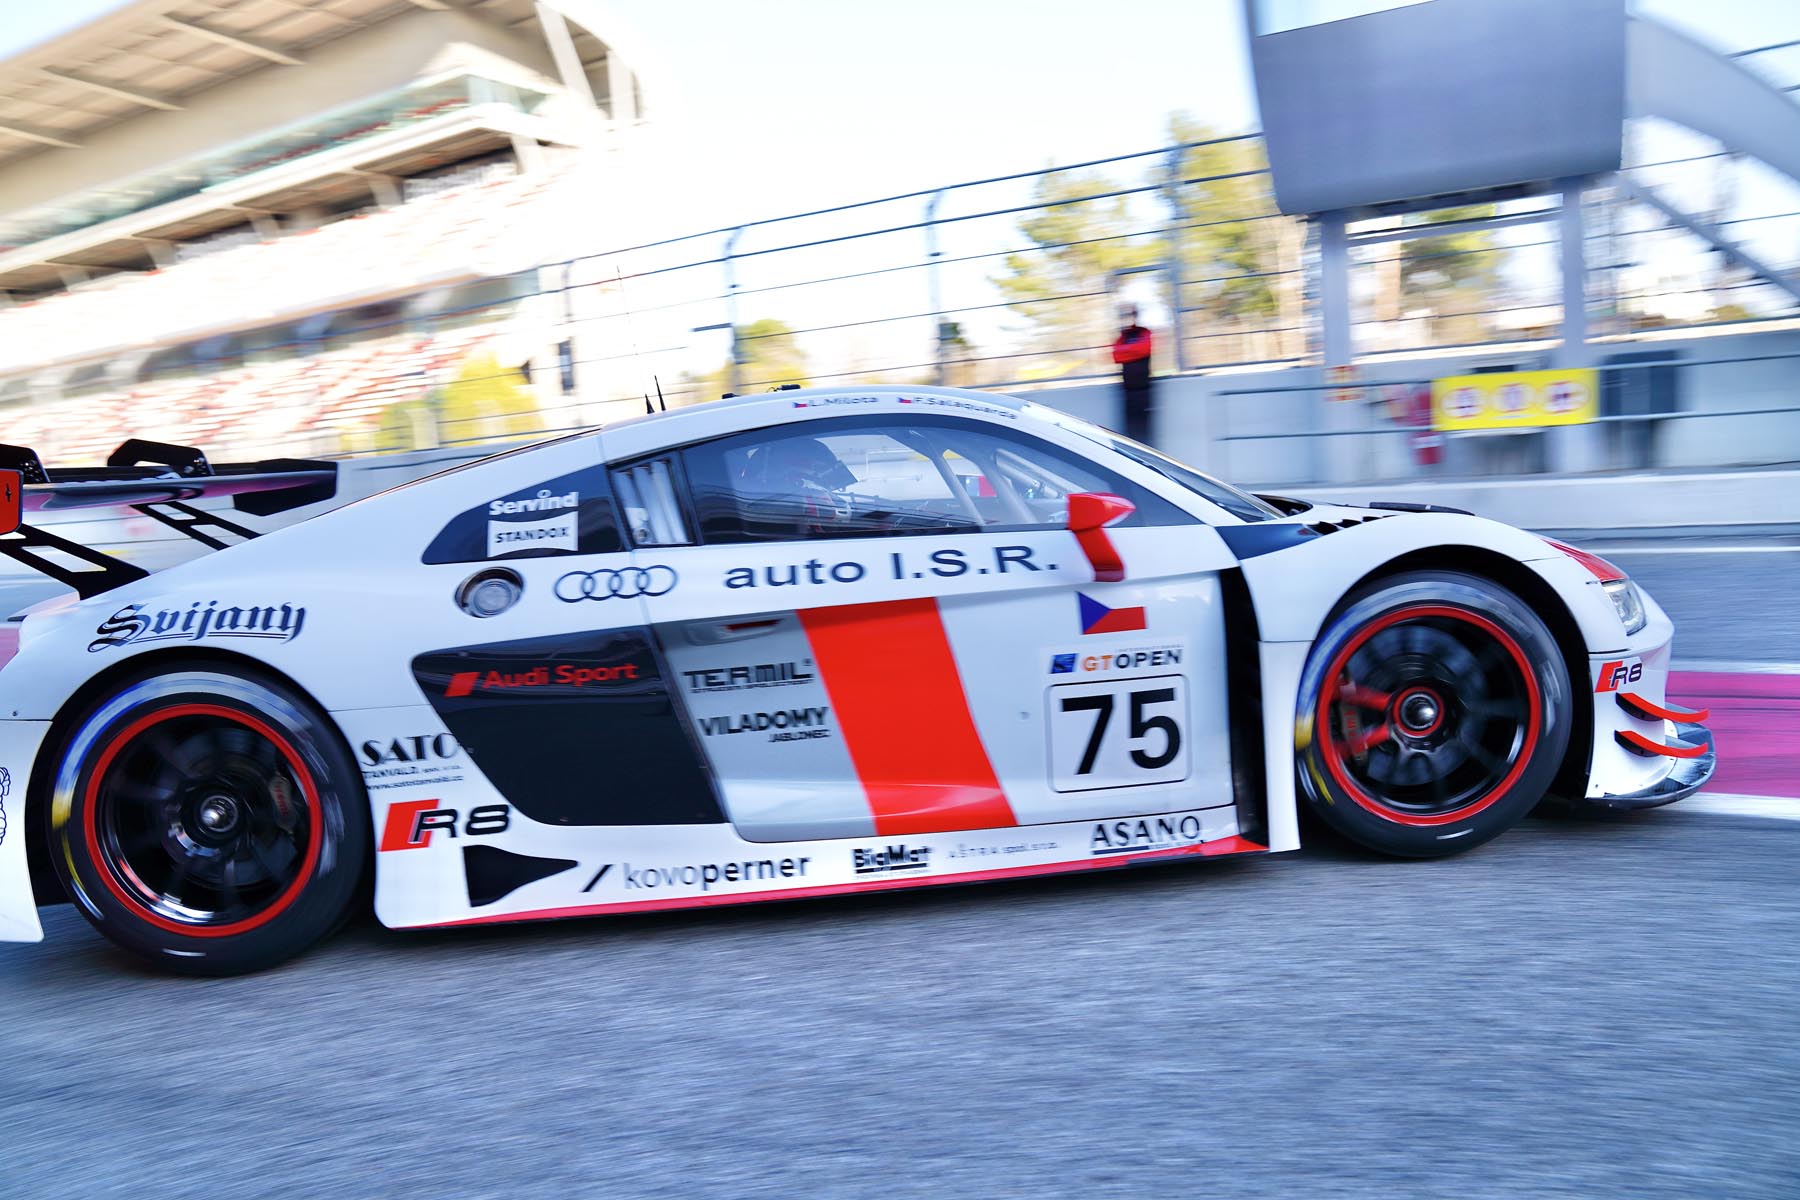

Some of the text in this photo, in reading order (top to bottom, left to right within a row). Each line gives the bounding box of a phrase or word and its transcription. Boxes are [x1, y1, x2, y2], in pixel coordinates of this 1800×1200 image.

[489, 489, 579, 515] Servind
[495, 527, 570, 543] STANDOX
[723, 545, 1060, 589] auto I.S.R.
[87, 600, 306, 652] Svijany
[482, 663, 639, 689] Audi Sport
[1060, 687, 1182, 775] 75
[360, 733, 459, 767] SATO
[1090, 815, 1201, 848] ASANO
[623, 856, 811, 892] kovoperner
